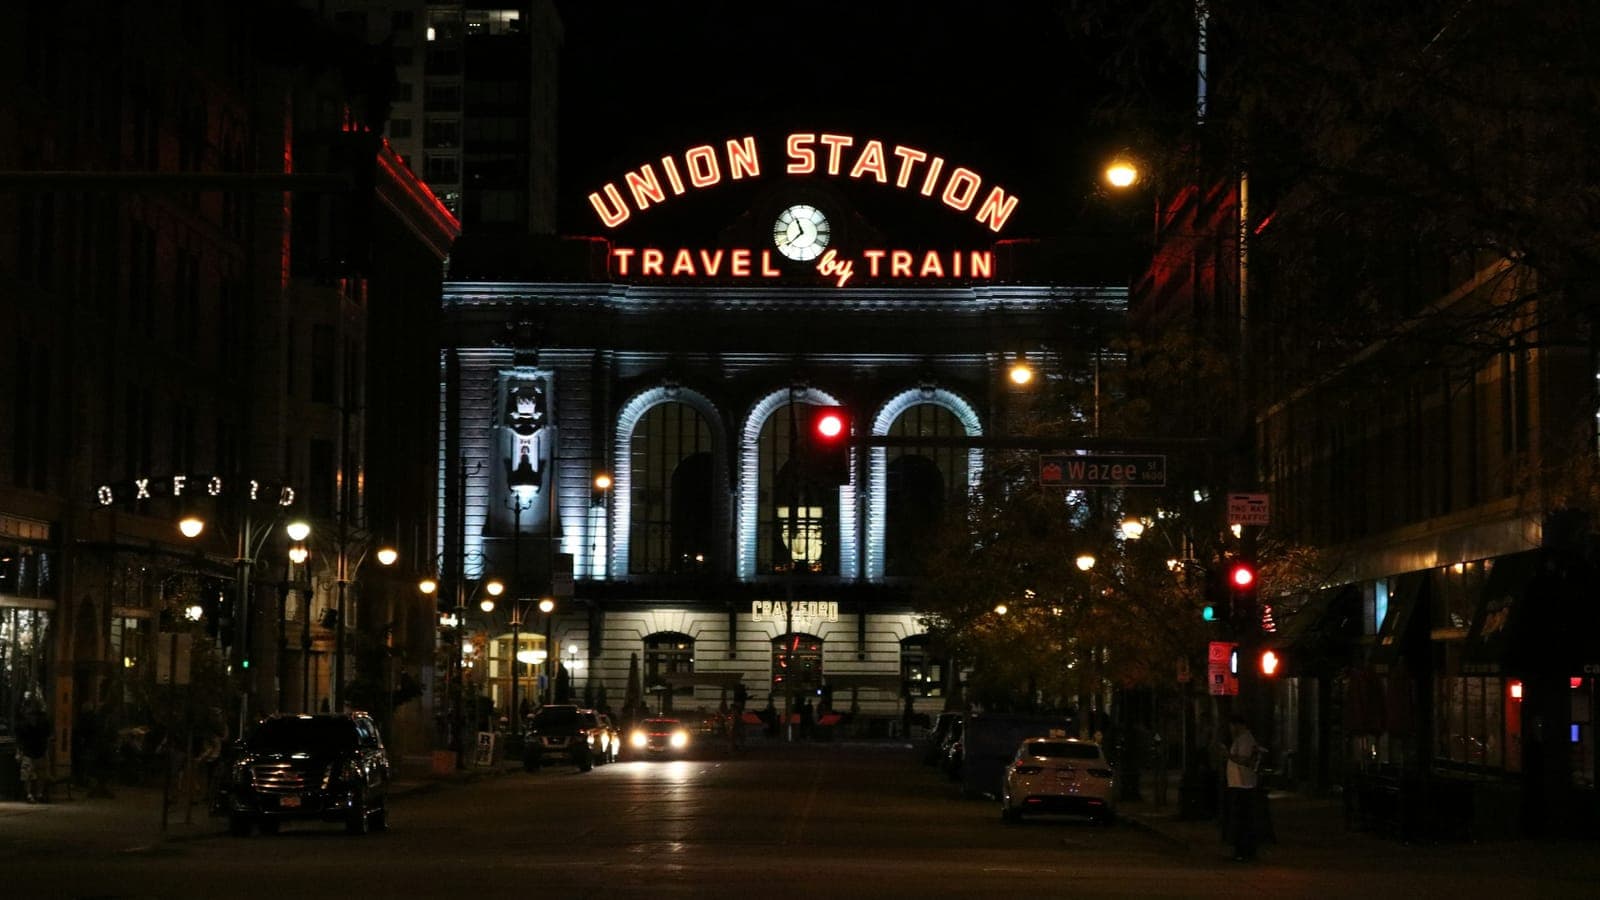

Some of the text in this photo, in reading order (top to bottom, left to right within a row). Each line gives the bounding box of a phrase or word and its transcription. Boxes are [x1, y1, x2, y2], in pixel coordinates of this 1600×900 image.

[588, 133, 1019, 232] UNION STATION
[614, 248, 993, 287] TRAVEL by TRAIN
[1067, 460, 1137, 481] Wazee
